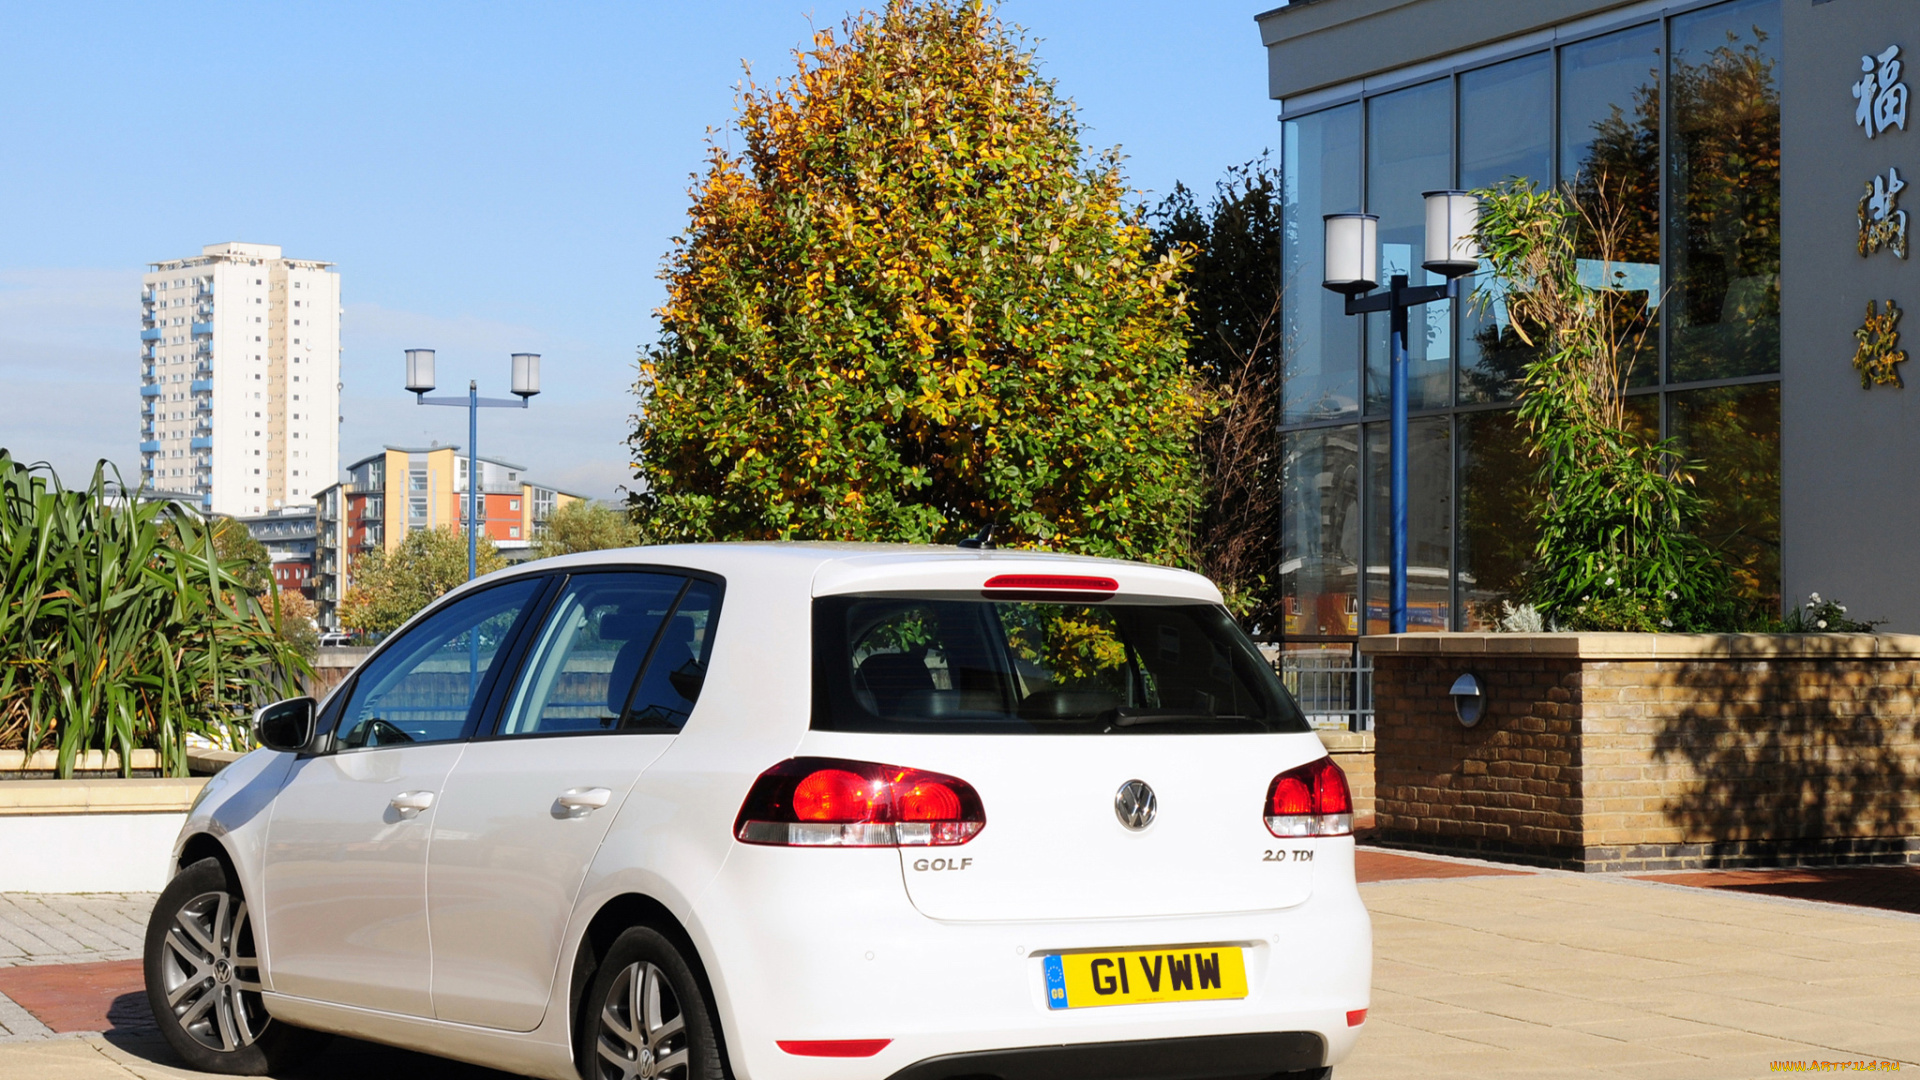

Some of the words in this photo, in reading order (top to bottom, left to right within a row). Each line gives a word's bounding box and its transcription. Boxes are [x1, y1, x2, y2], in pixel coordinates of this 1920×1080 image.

[1262, 849, 1286, 862] 2.0
[1292, 849, 1314, 862] TDI
[913, 857, 973, 872] GOLF
[1139, 952, 1222, 993] VWW
[1051, 988, 1065, 999] GB
